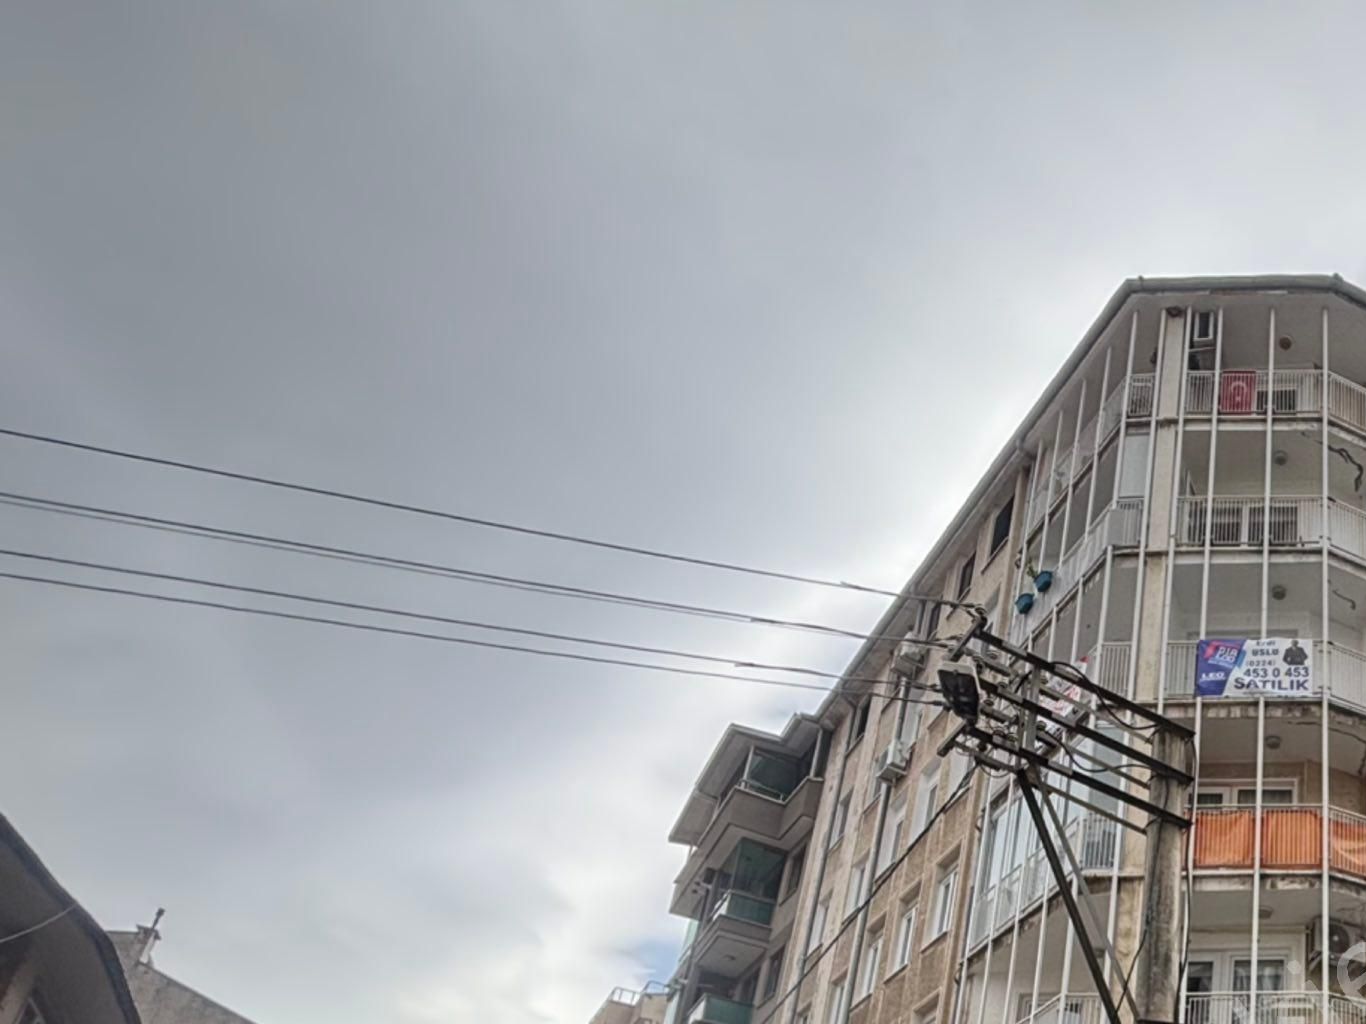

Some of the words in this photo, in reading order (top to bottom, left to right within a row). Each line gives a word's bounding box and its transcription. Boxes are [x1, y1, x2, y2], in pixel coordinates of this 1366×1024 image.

[1243, 668, 1268, 678] 453
[1272, 667, 1281, 678] 0
[1285, 666, 1310, 678] 453
[1234, 677, 1309, 691] SATILIK
